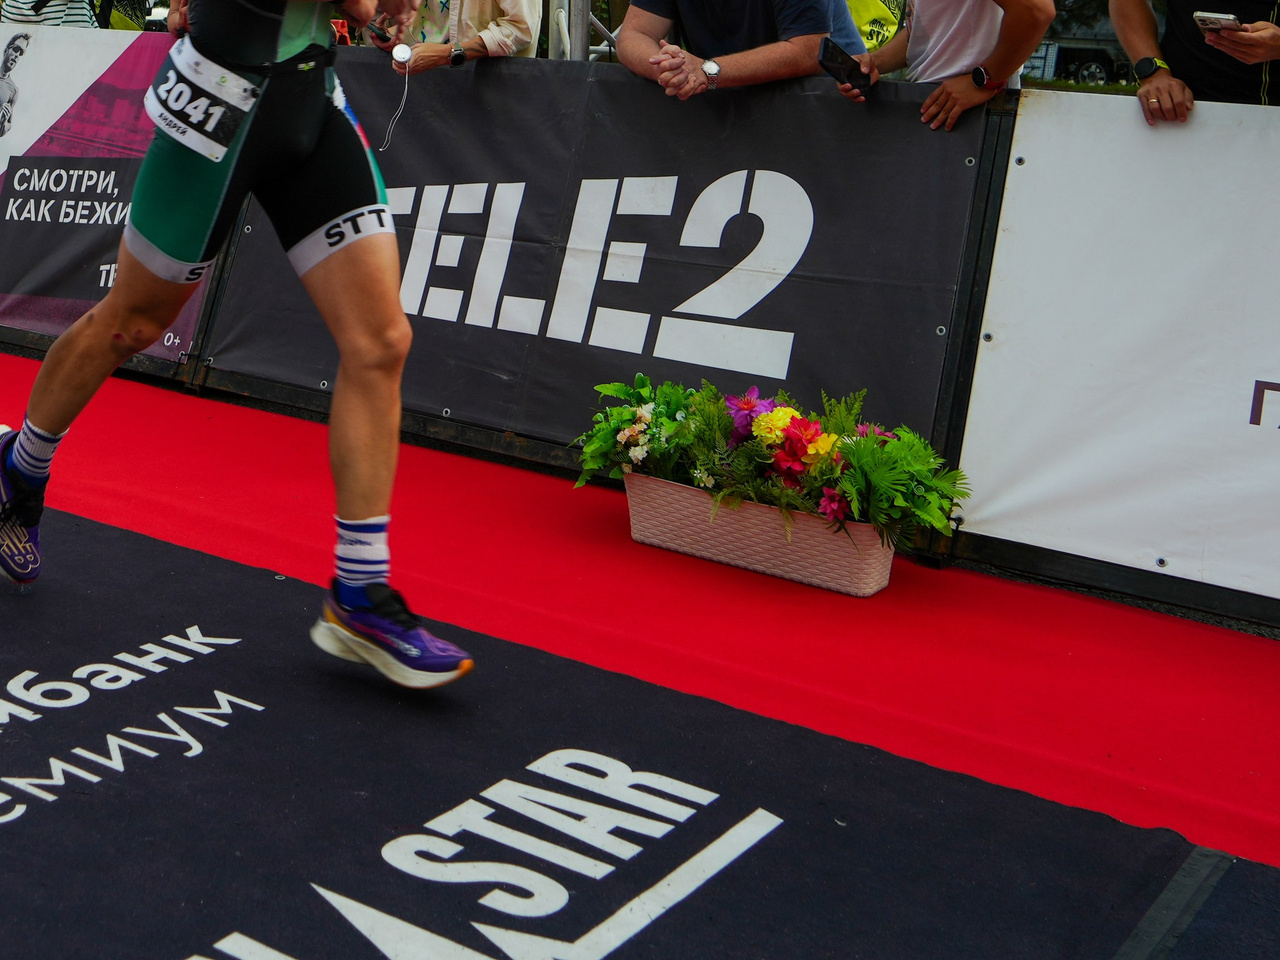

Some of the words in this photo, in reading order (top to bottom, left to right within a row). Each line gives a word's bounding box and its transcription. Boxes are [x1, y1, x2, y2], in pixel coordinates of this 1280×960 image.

[157, 69, 227, 133] 2041
[13, 167, 119, 198] СМОТРИ,
[5, 198, 55, 222] КАК
[324, 208, 386, 247] STT
[164, 332, 181, 346] 0+
[381, 746, 720, 918] STAR
